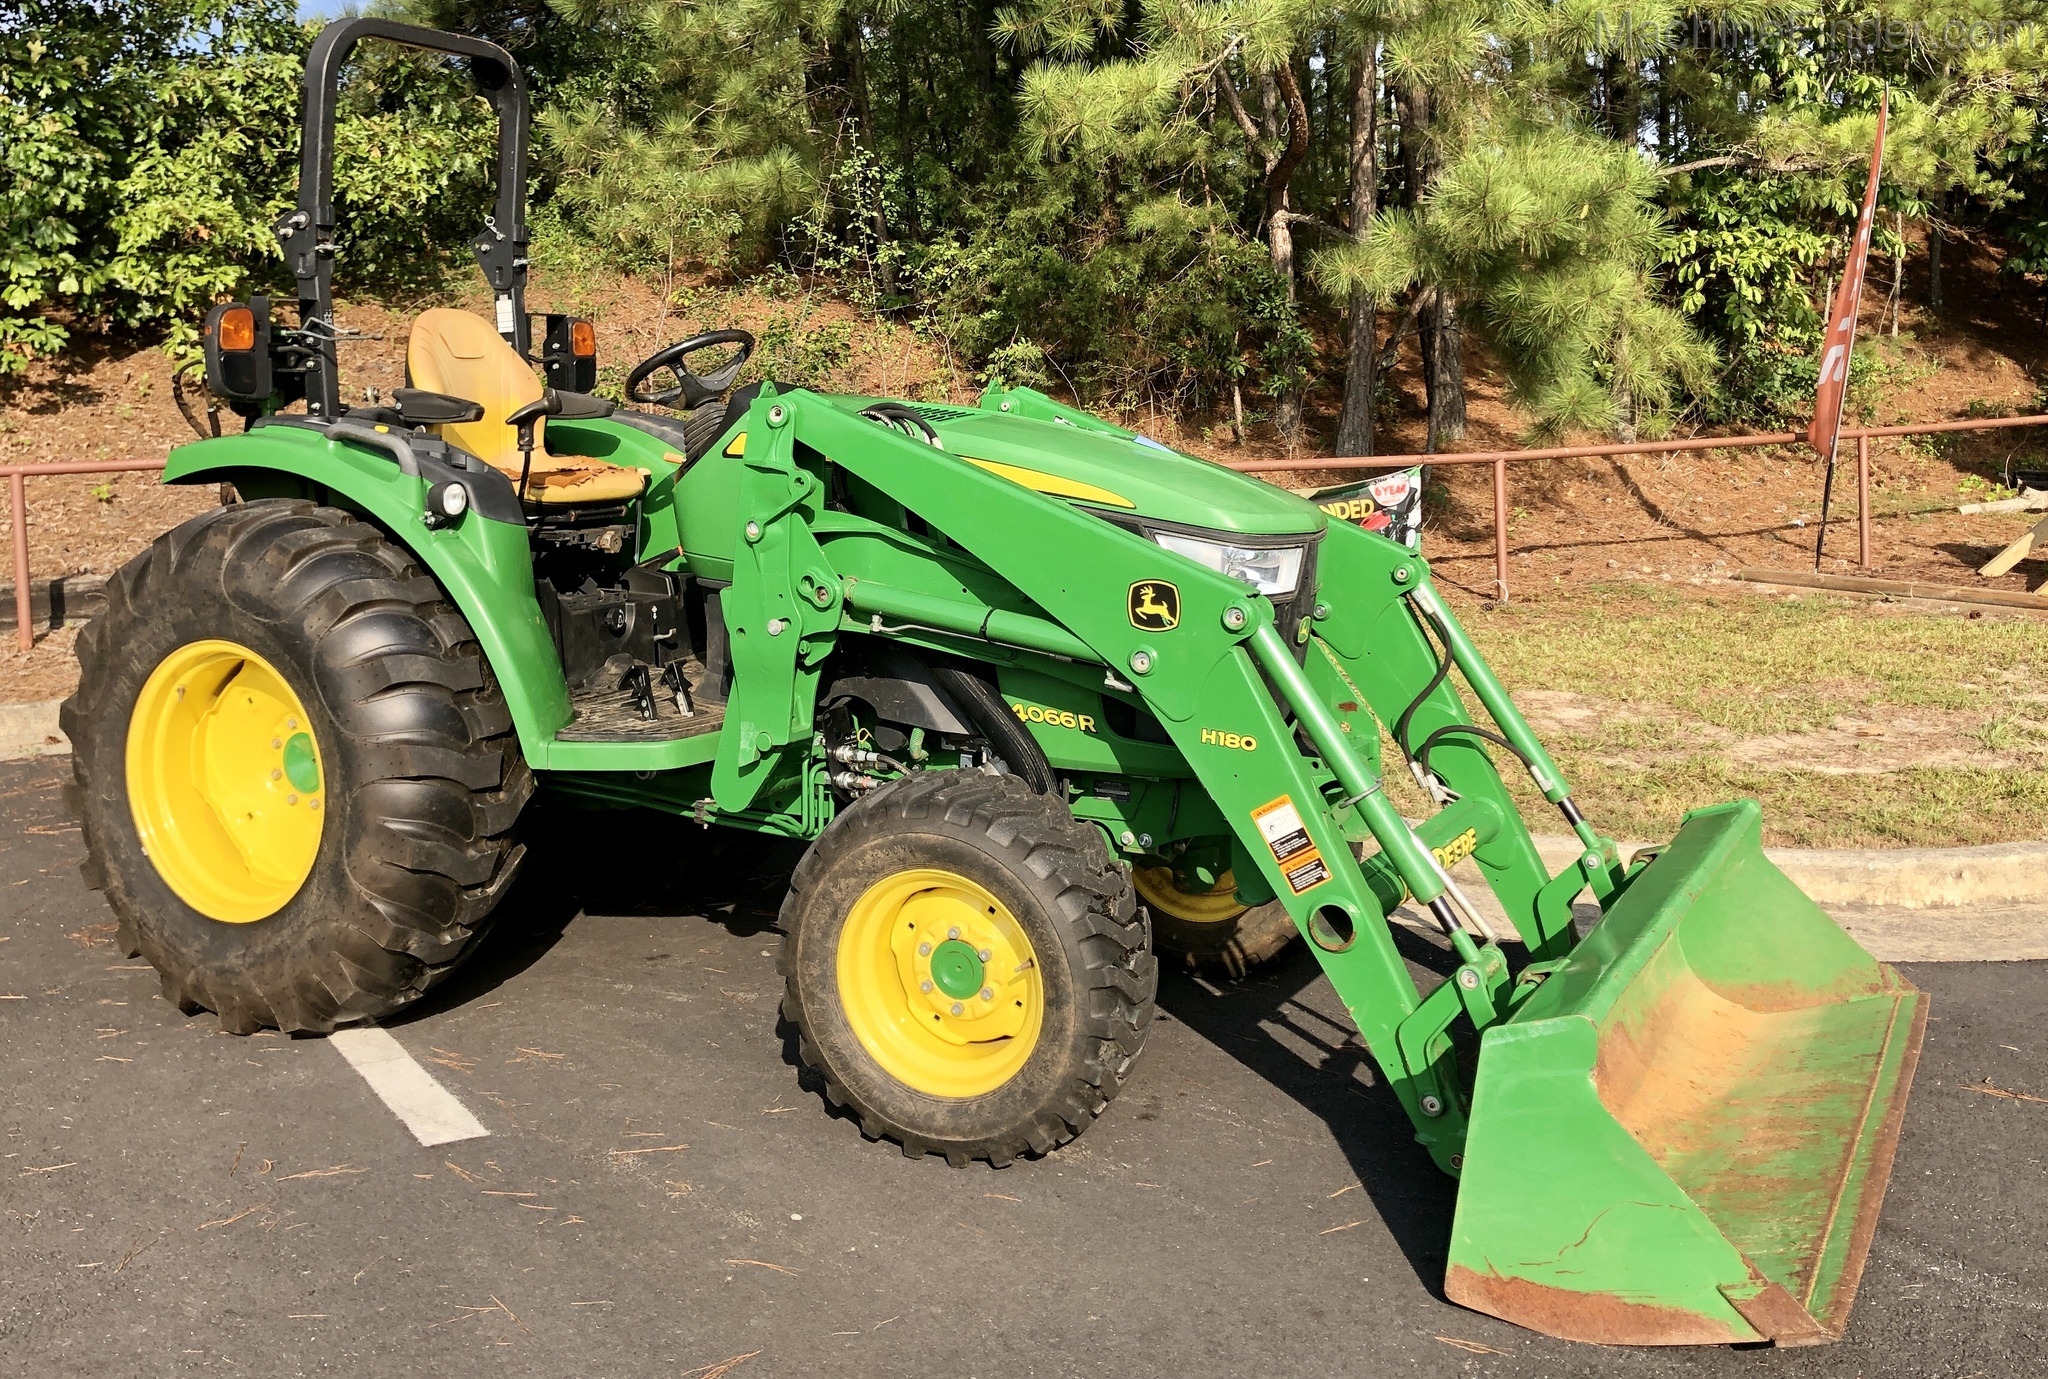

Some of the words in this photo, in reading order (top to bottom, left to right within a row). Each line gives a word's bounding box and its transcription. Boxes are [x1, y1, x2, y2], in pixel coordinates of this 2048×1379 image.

[1374, 486, 1382, 496] 6
[1382, 484, 1407, 496] YEAR
[1201, 728, 1257, 752] H180
[1261, 799, 1285, 813] WARNING
[1430, 826, 1477, 870] DEERE
[1291, 853, 1316, 868] WARNING
